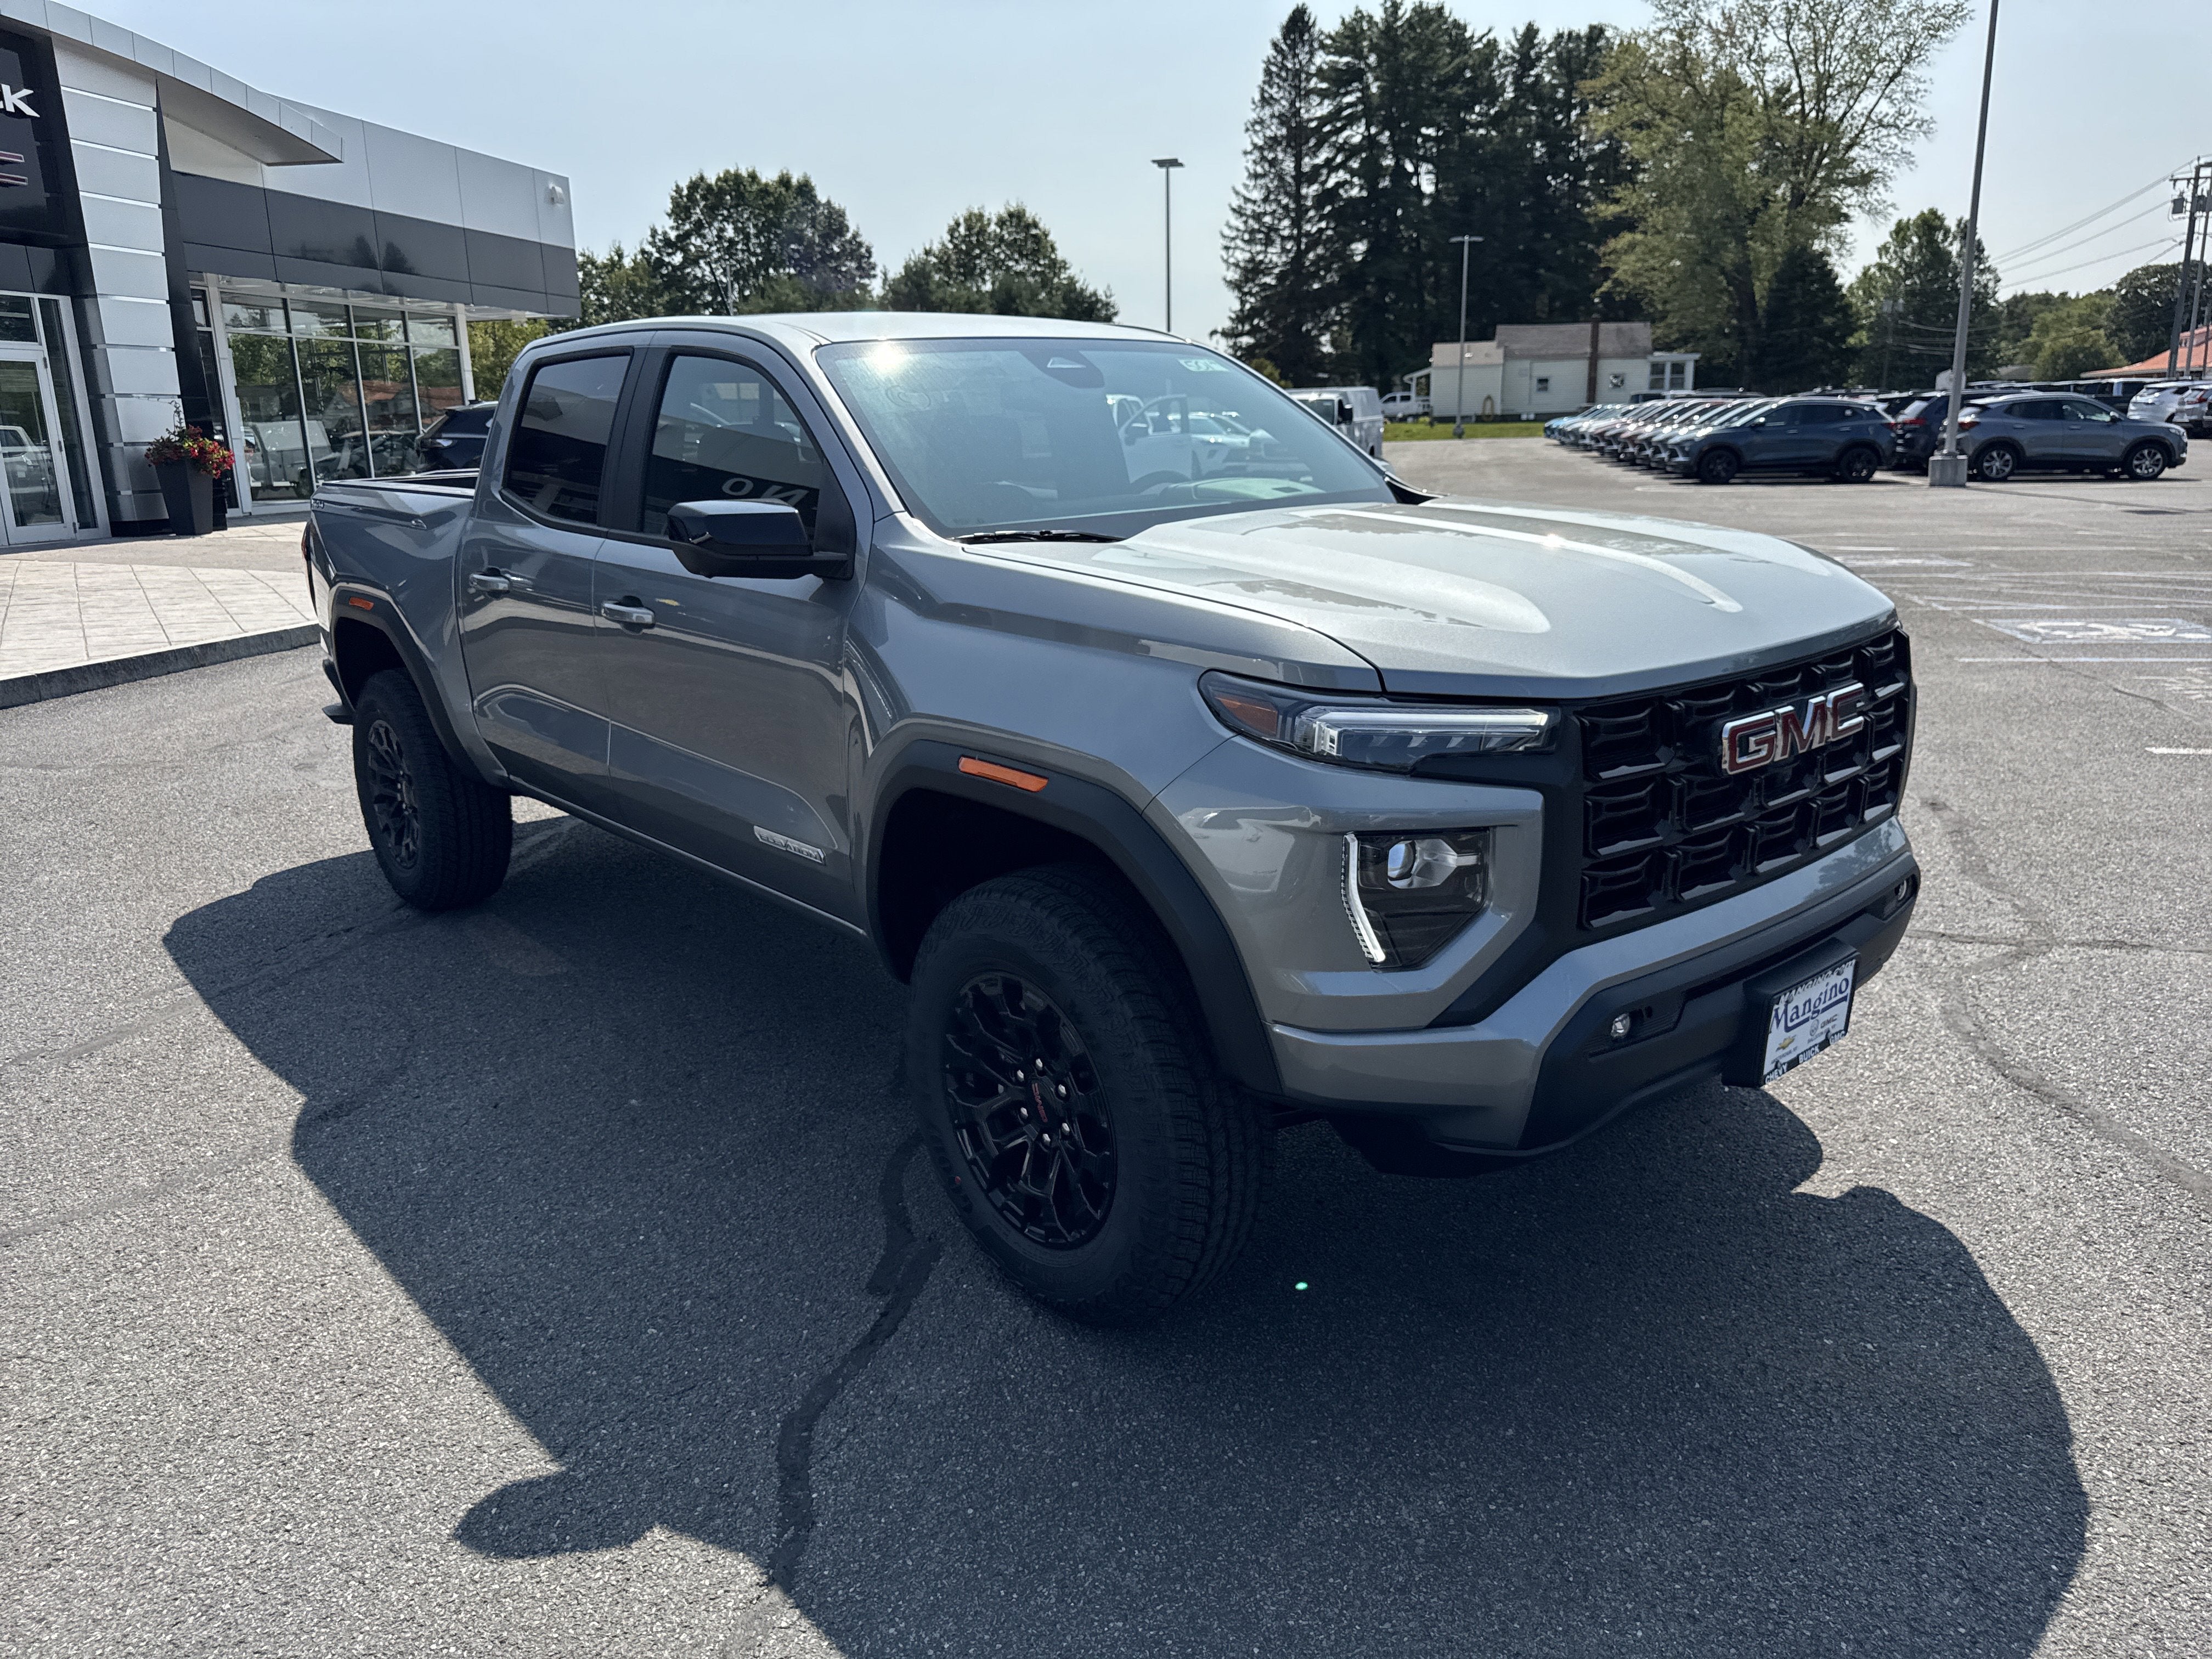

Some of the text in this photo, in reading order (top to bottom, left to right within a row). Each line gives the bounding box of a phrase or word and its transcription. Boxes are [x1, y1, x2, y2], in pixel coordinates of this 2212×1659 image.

[1722, 682, 1865, 775] GMC
[759, 833, 821, 861] ELEVATION
[1770, 978, 1849, 1032] Mangino
[1820, 1014, 1837, 1029] GMC
[1765, 1063, 1788, 1084] CHEVY
[1798, 1043, 1820, 1063] BUICK
[1829, 1030, 1846, 1045] GMC
